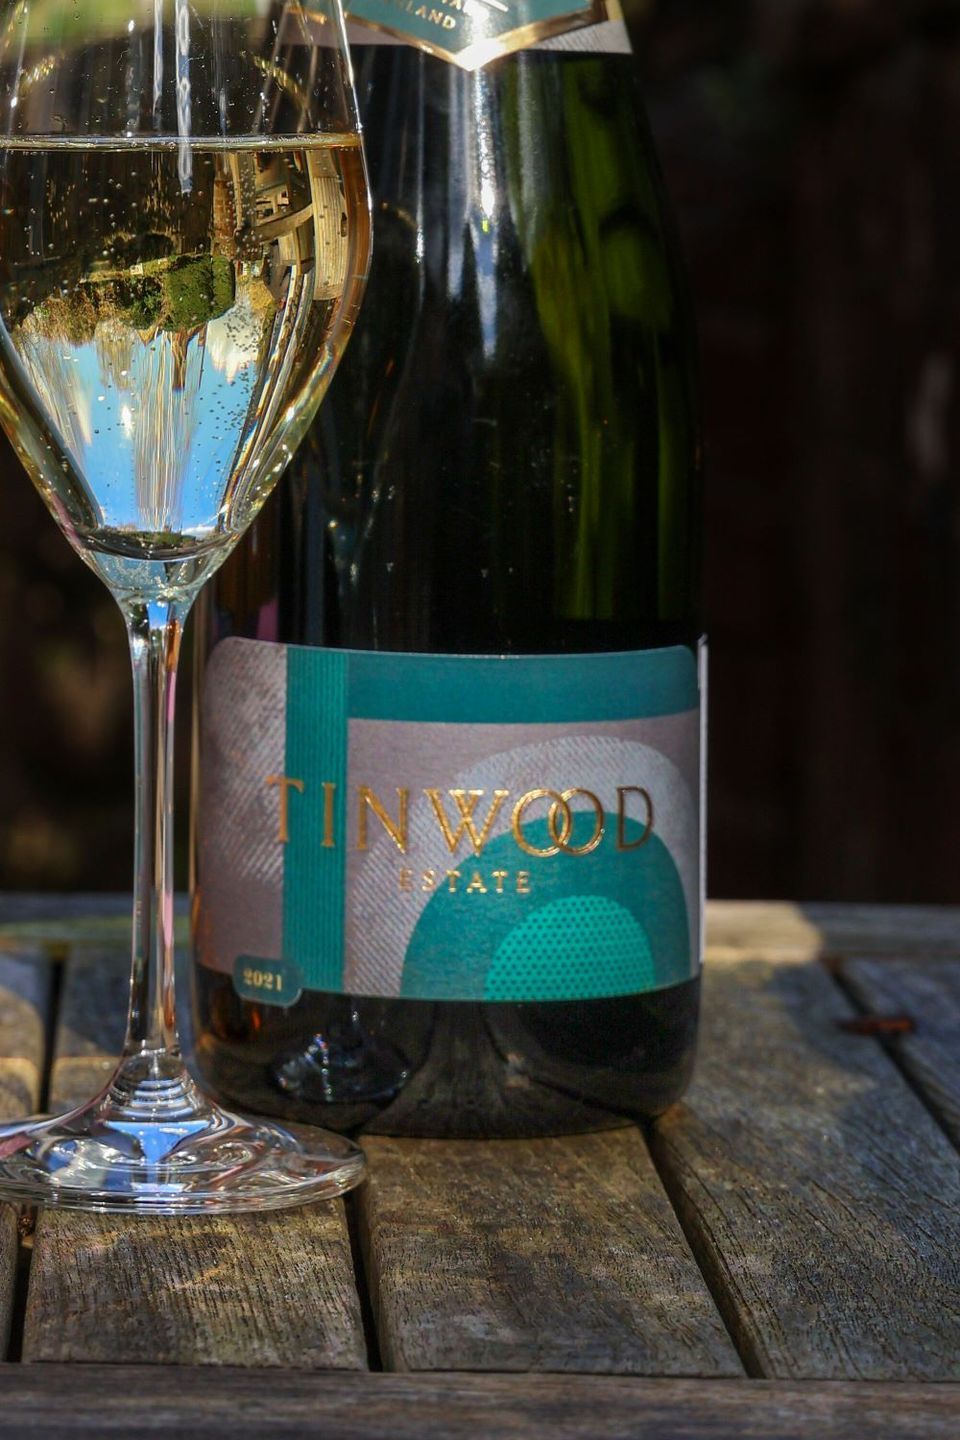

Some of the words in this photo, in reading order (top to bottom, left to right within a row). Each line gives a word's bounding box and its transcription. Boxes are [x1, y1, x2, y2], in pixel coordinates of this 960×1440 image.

[265, 774, 655, 857] TINWOOD
[399, 868, 532, 894] ESTATE
[243, 968, 282, 992] 2021
